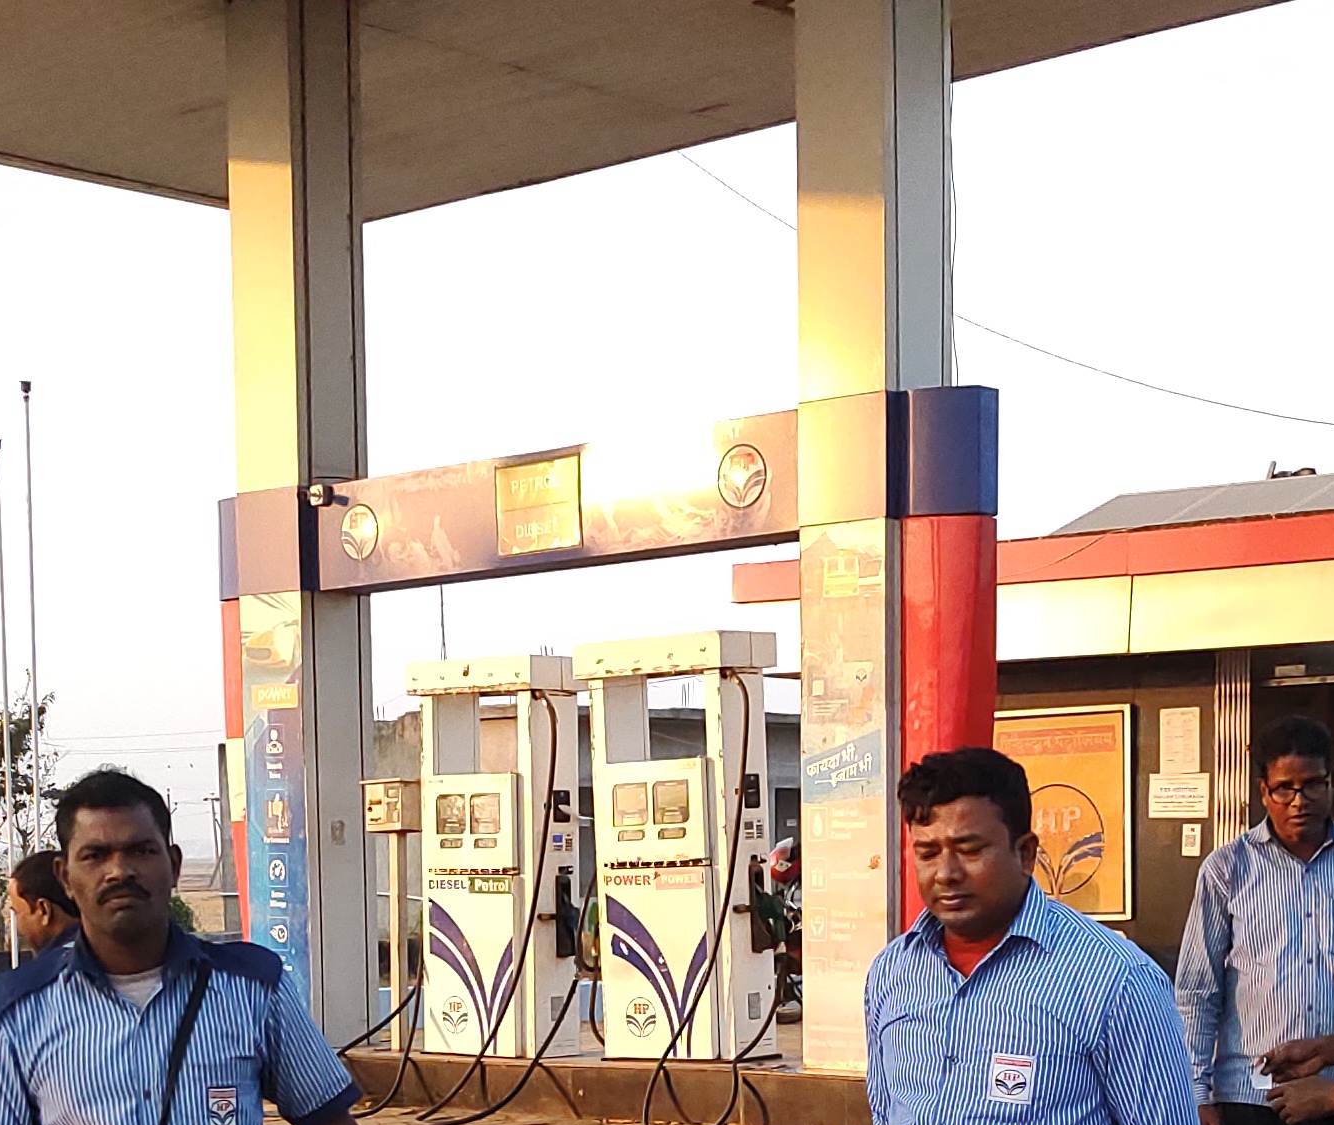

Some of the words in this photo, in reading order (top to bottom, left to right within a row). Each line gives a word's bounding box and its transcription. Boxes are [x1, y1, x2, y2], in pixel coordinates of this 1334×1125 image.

[605, 874, 652, 886] POWER
[661, 871, 699, 885] POWER
[474, 877, 509, 892] Petrol
[633, 1003, 650, 1015] HP
[1002, 1072, 1021, 1082] HP
[216, 1102, 231, 1112] HP
